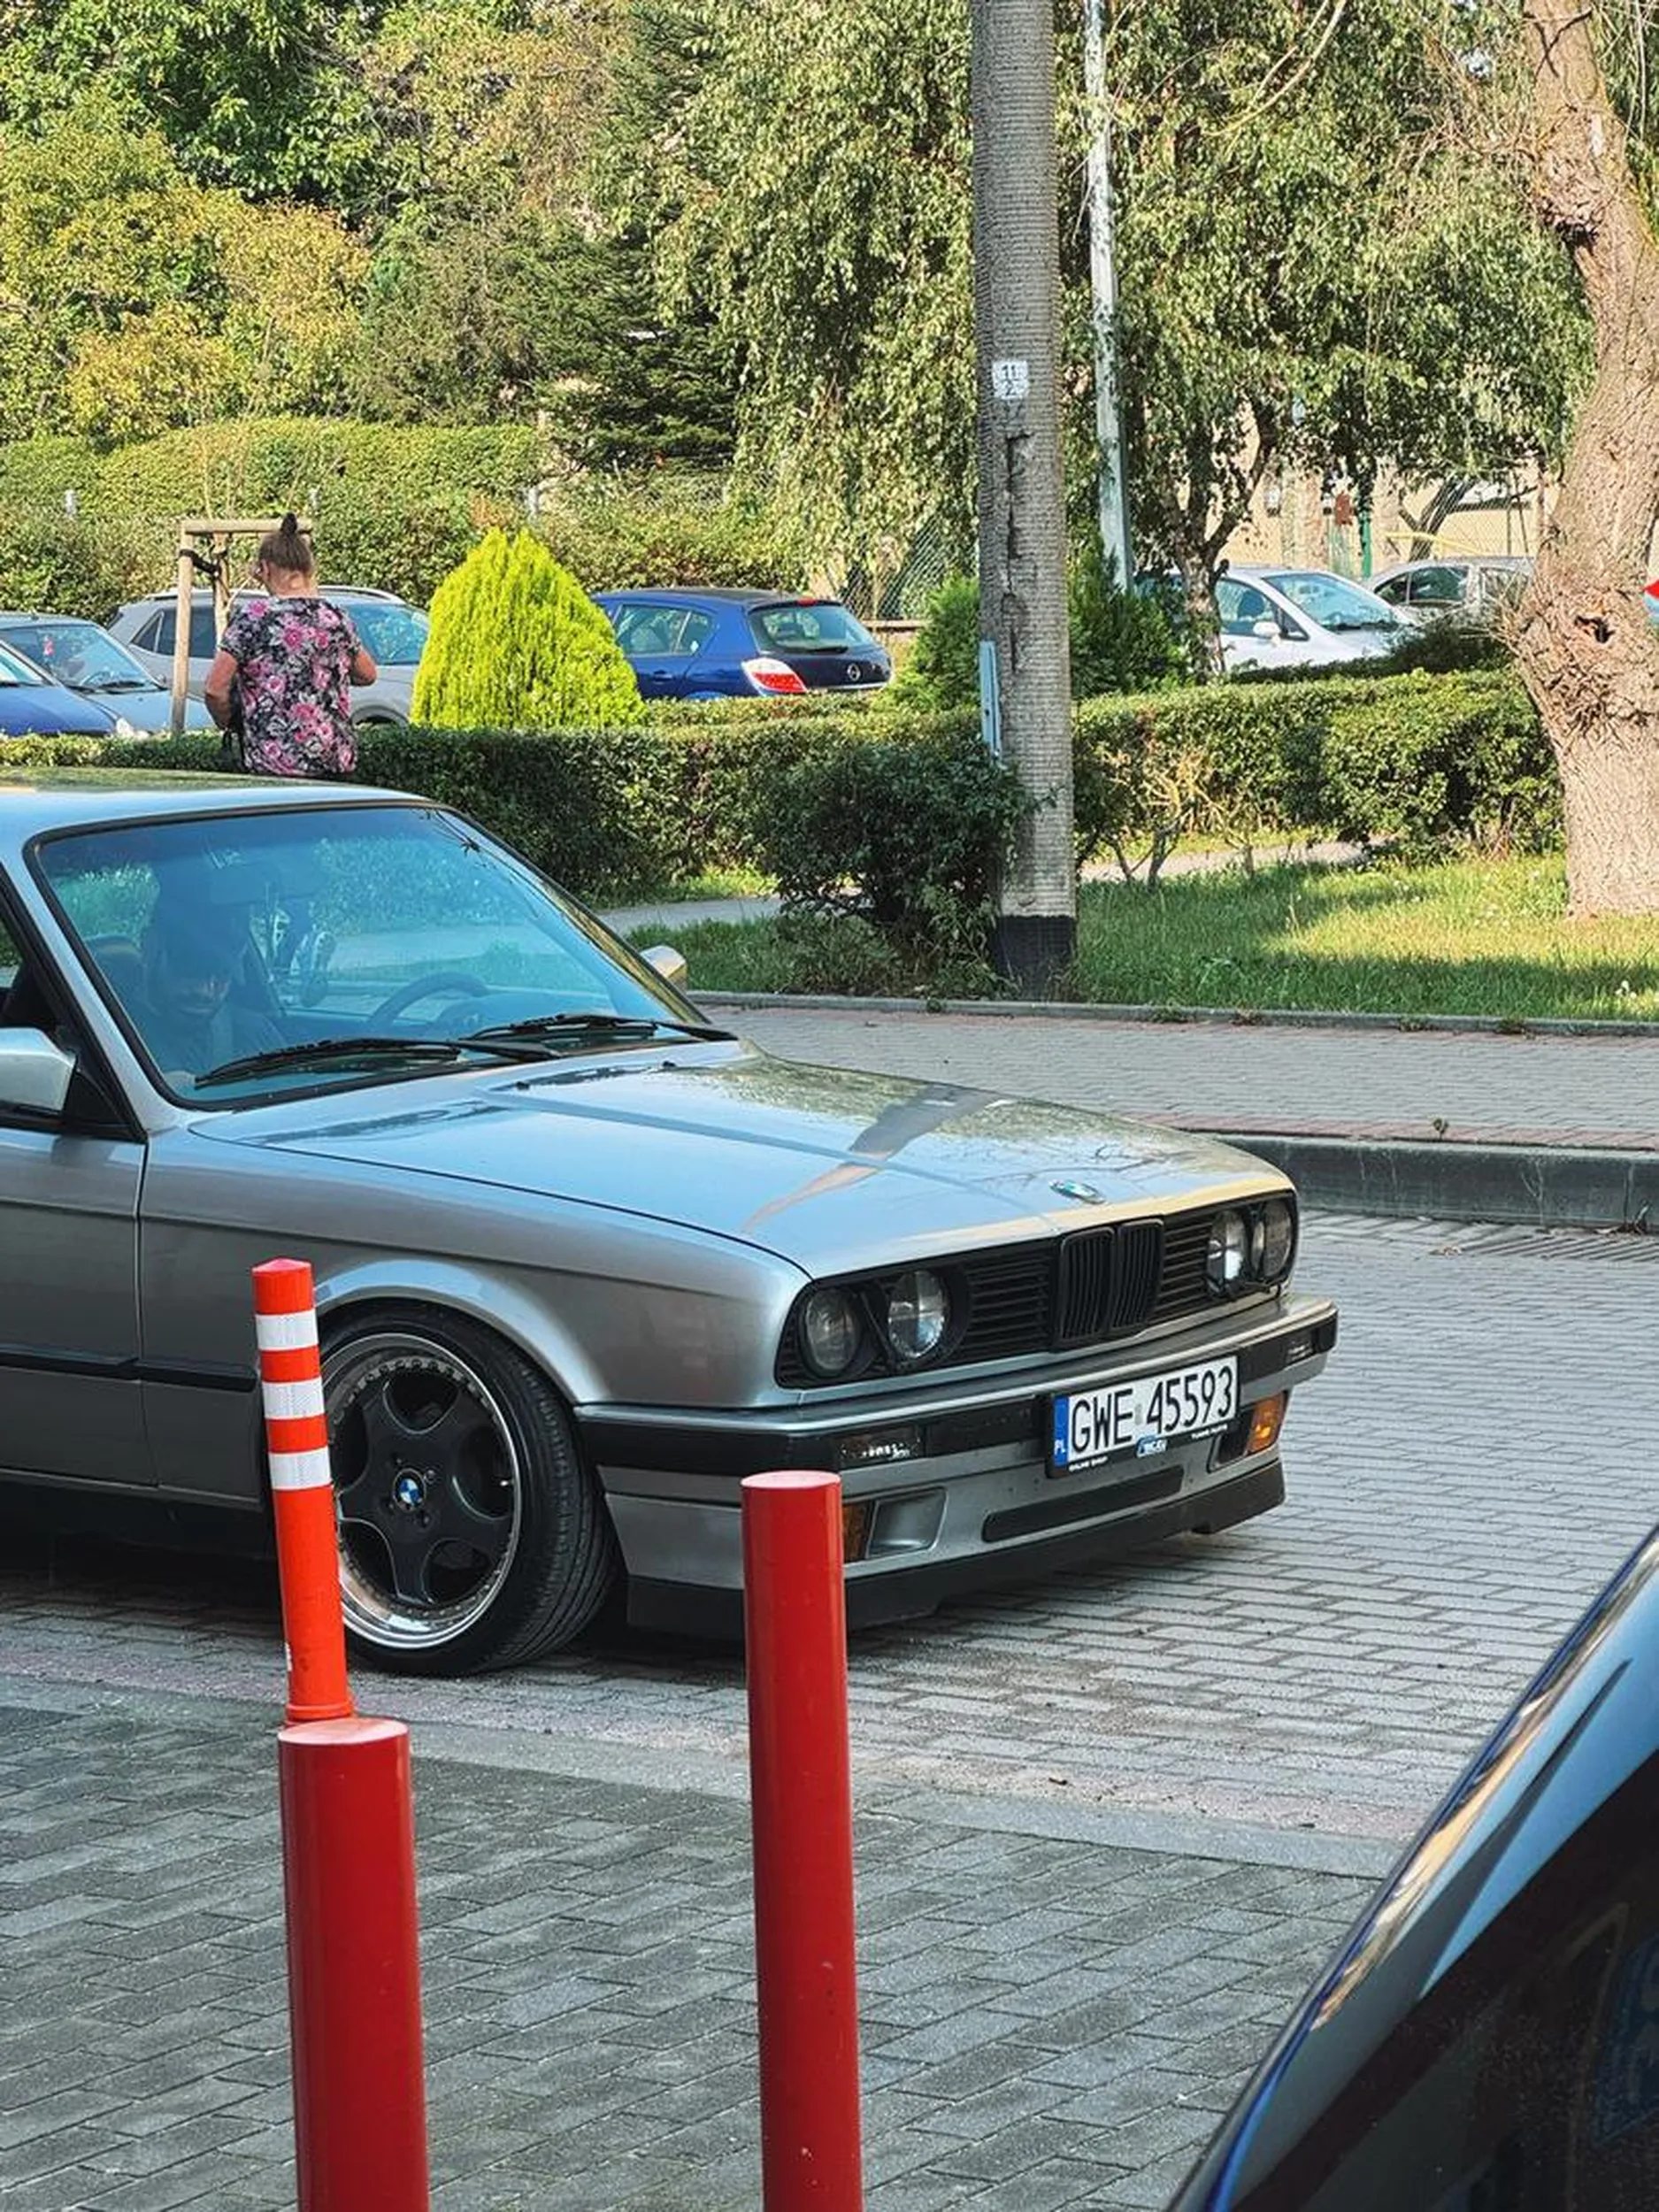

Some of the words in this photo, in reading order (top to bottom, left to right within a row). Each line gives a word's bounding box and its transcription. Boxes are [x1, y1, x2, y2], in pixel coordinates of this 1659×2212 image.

[1071, 1389, 1133, 1453] GWE
[1147, 1365, 1233, 1434] 45593
[1054, 1440, 1066, 1455] PL
